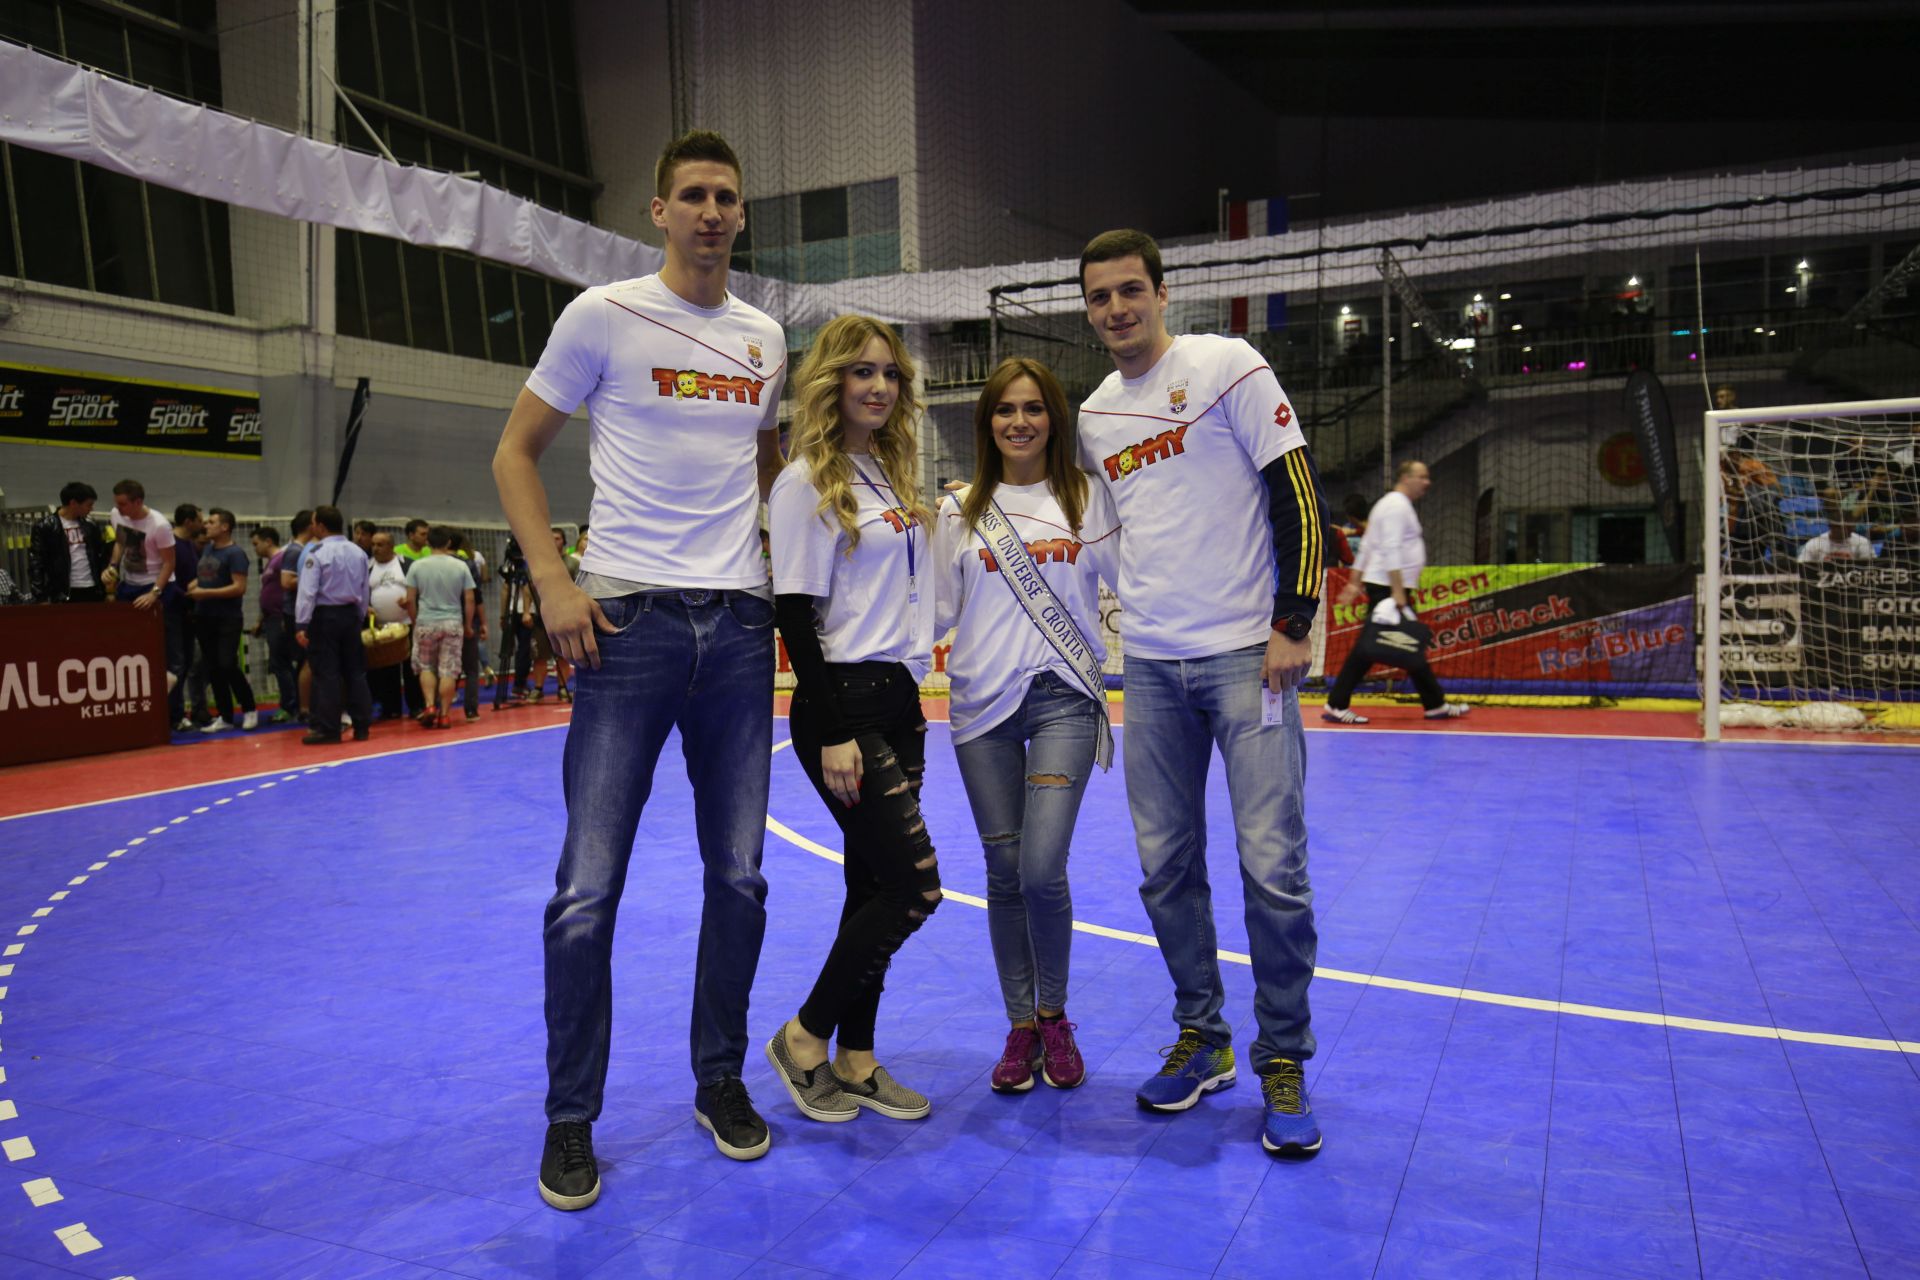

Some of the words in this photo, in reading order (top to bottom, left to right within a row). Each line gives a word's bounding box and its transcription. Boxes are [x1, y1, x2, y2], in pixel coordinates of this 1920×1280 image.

[652, 368, 765, 406] TOMMY
[49, 396, 120, 427] Sport
[147, 406, 209, 434] Sport
[1103, 425, 1188, 482] TOMMY
[979, 538, 1082, 573] TMMY
[1816, 567, 1909, 588] ZAGREB
[996, 534, 1043, 601] UNIVERSE
[1041, 606, 1084, 661] CROATIA
[81, 703, 137, 719] KELME
